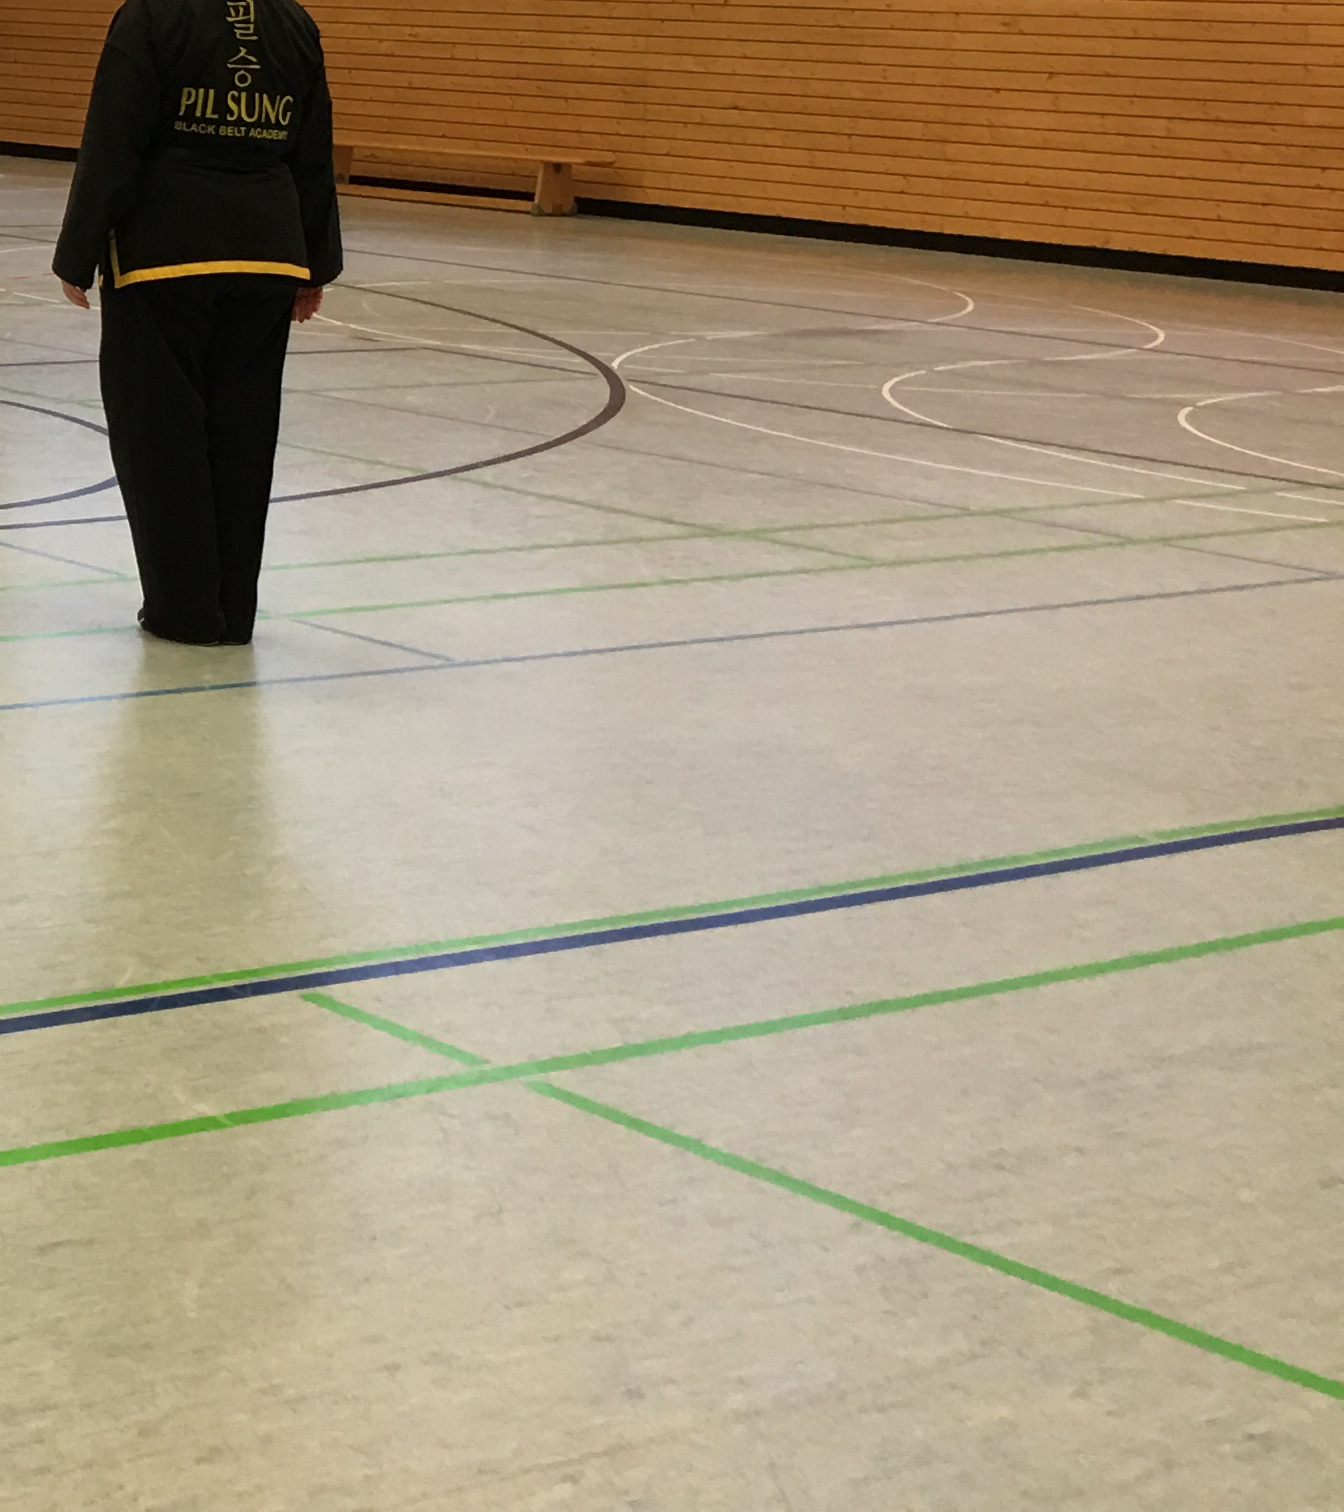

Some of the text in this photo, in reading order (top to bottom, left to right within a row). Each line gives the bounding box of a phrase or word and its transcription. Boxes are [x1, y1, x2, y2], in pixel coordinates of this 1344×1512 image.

[178, 87, 294, 126] PIL SUNG
[173, 120, 216, 135] BLACK
[218, 125, 246, 137] BELT
